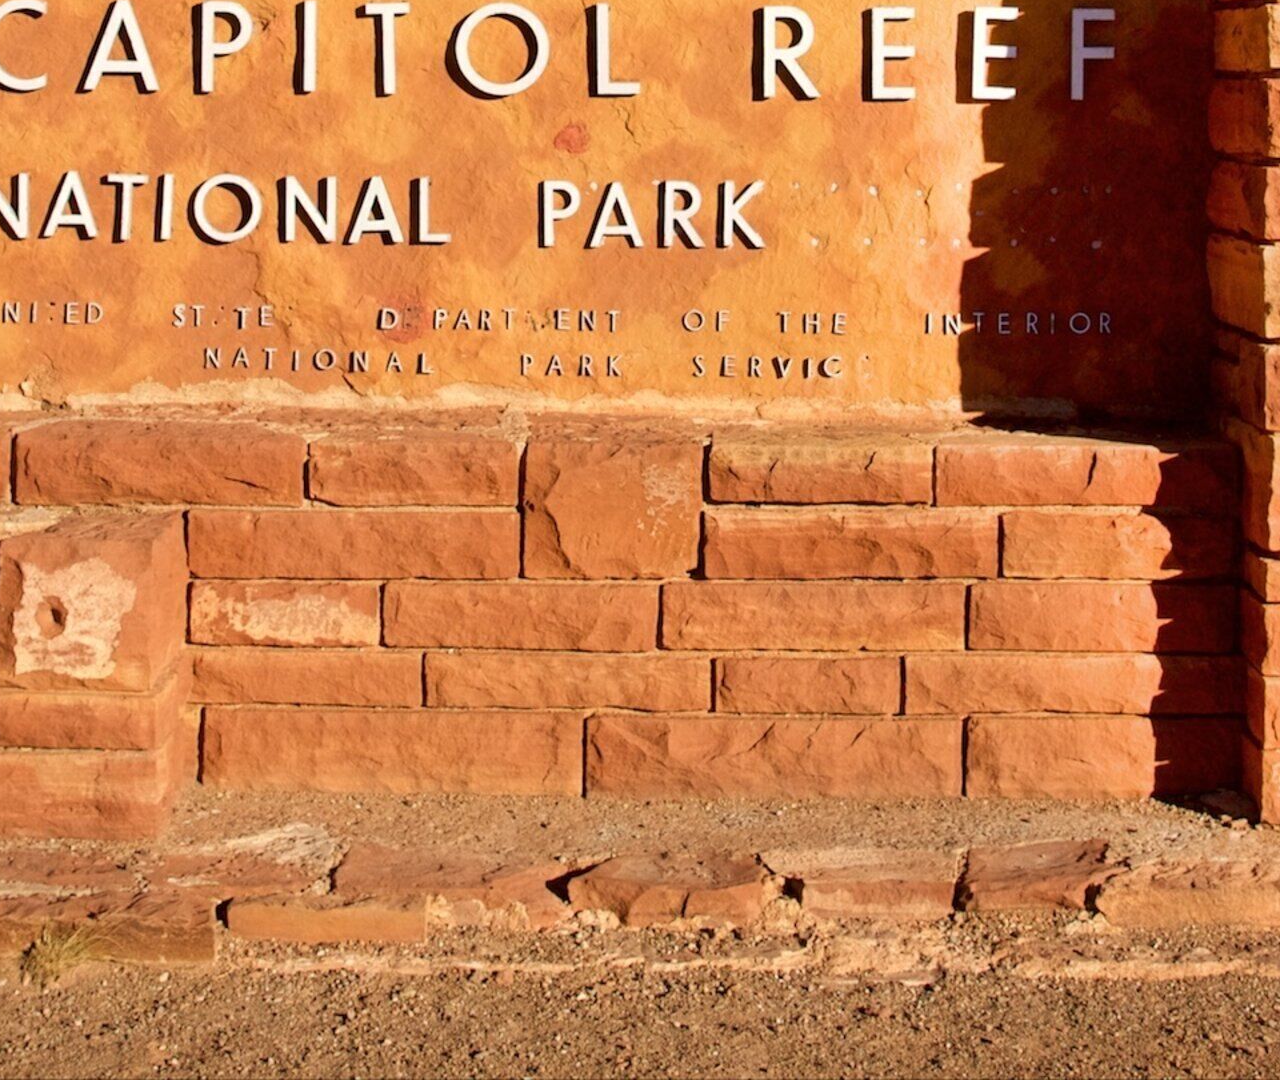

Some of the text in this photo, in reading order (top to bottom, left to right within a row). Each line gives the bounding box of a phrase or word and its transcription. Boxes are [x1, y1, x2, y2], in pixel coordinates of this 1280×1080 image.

[762, 5, 1116, 101] REEF
[542, 179, 766, 249] PARK
[173, 303, 292, 329] STTE
[378, 307, 620, 332] DPARTENT
[682, 309, 730, 332] OF
[778, 311, 848, 335] THE
[925, 311, 1112, 335] INTERIOR
[204, 346, 870, 379] NATIONAL PARK SERVIC
